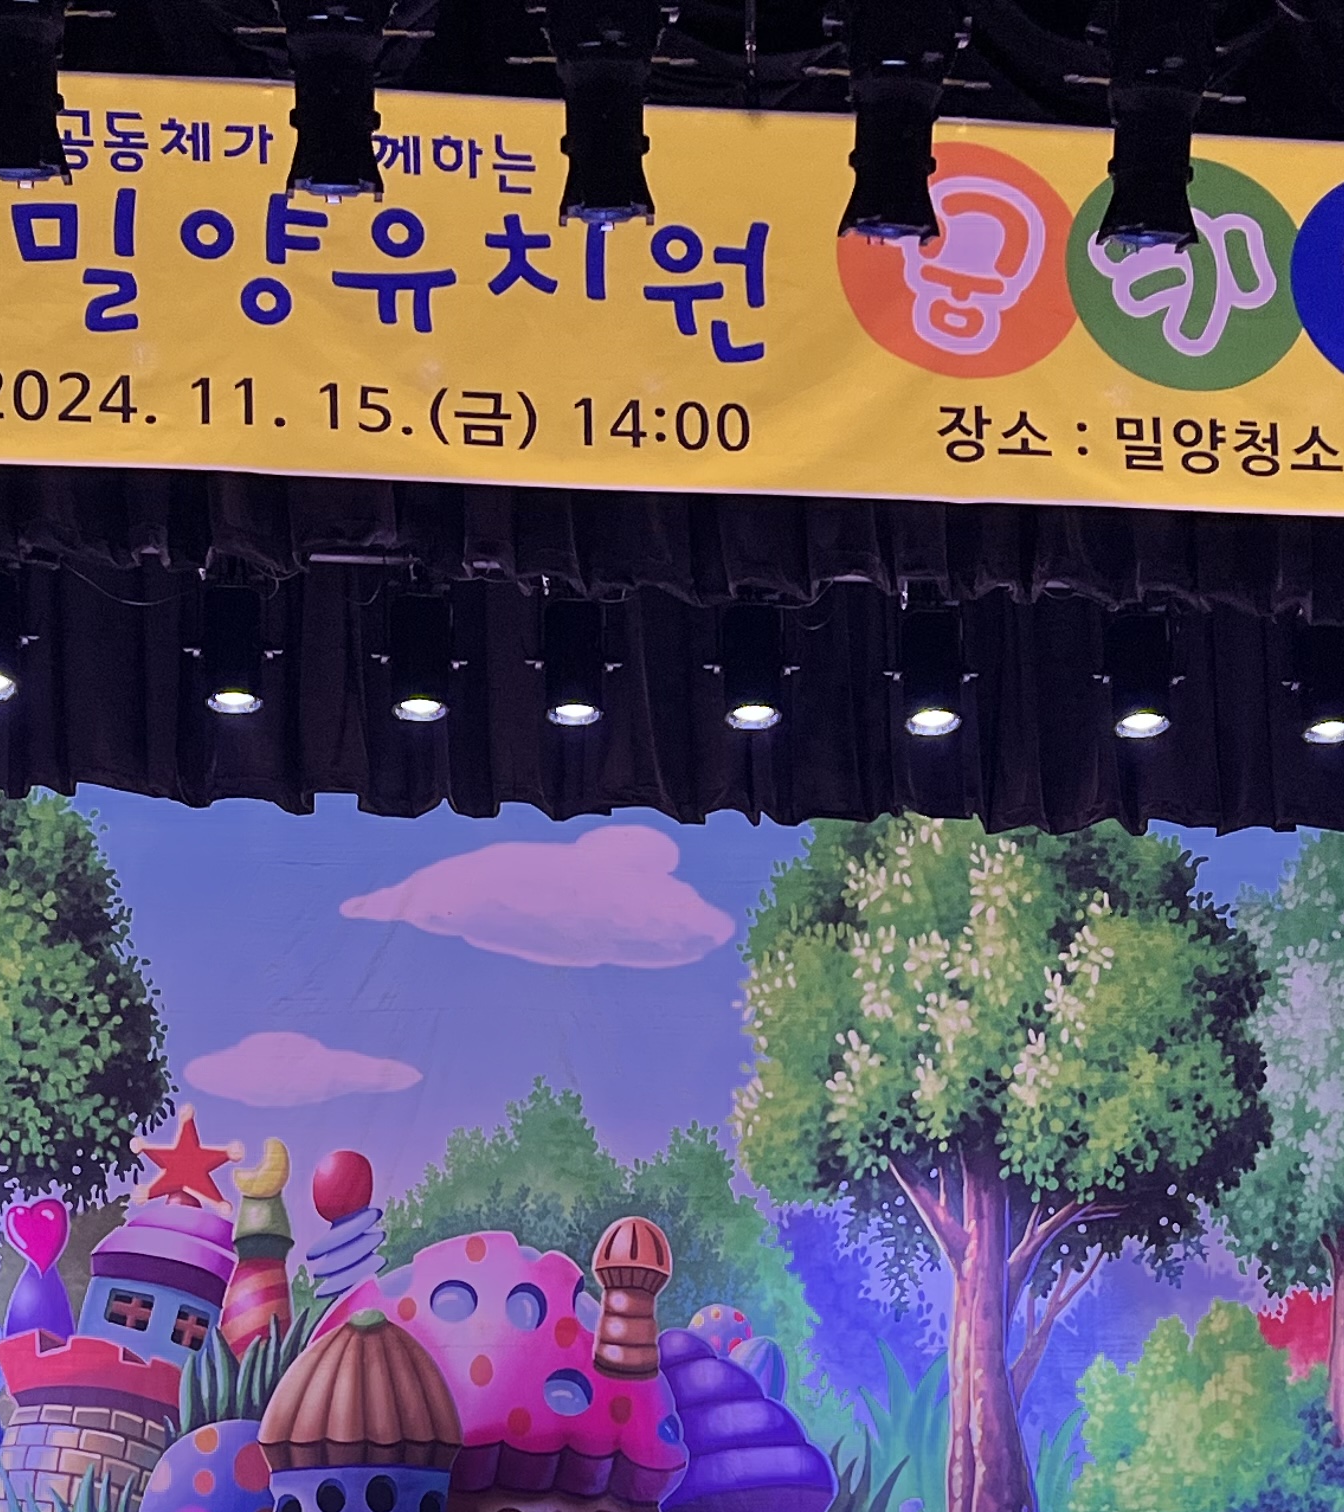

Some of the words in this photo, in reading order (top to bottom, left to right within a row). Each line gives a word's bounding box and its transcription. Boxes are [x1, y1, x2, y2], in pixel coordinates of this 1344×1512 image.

[373, 132, 538, 195] 께하는
[13, 186, 768, 362] 밀양유치원
[190, 376, 287, 428] 11.
[318, 381, 538, 450] 15.(금)
[573, 396, 751, 453] 14:00
[936, 405, 1054, 463] 장소
